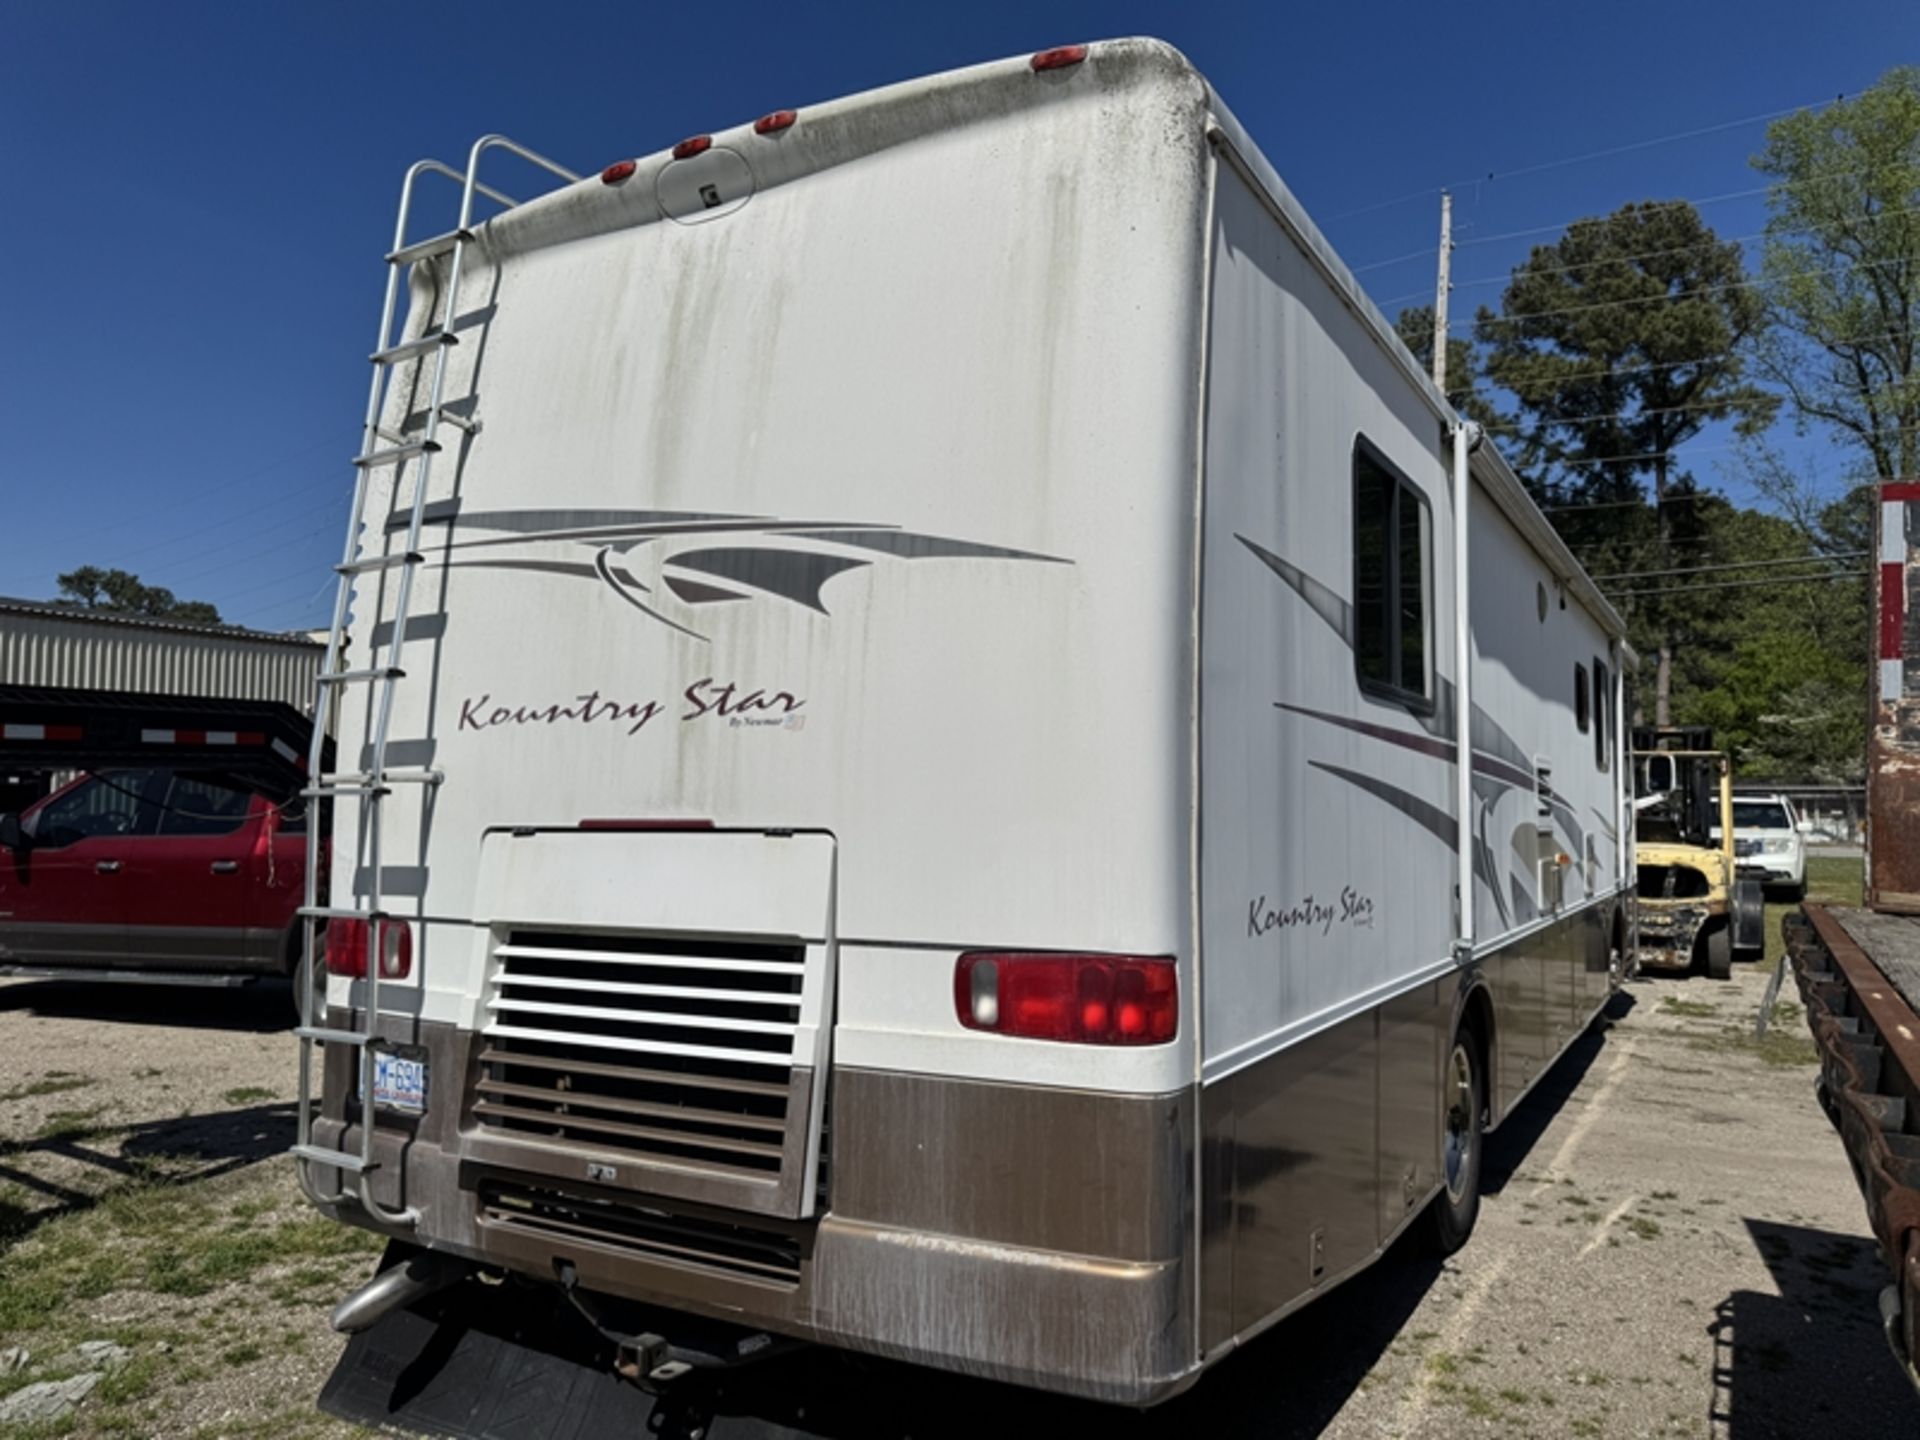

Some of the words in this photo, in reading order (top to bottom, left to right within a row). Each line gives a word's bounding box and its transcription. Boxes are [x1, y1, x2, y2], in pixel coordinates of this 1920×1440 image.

[457, 690, 665, 736] Kountry
[681, 677, 806, 720] Star
[1247, 894, 1334, 938] Kountry
[1340, 885, 1374, 922] Star
